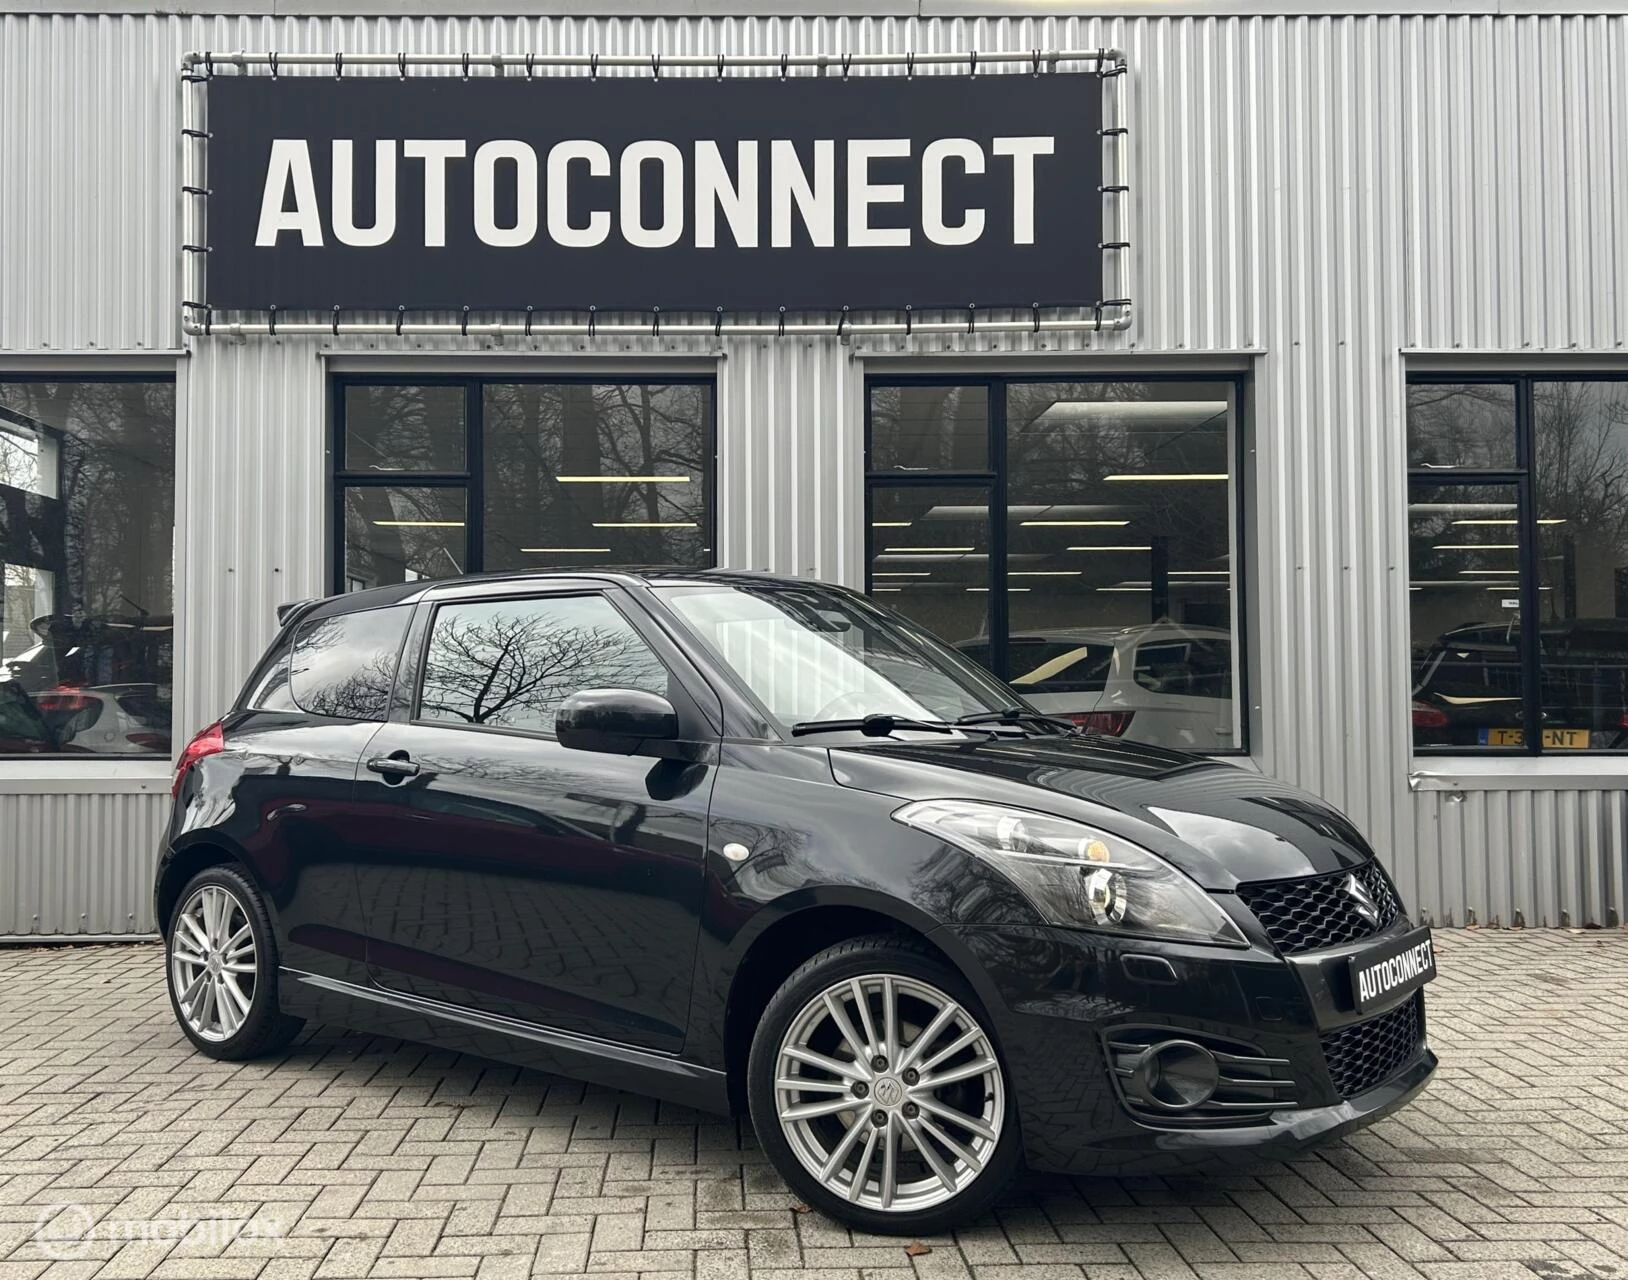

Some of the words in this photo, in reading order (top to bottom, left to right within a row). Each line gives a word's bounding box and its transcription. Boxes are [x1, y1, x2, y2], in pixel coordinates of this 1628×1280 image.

[255, 137, 1054, 247] AUTOCONNECT
[1498, 730, 1577, 746] T-3-NT
[1359, 940, 1432, 1002] AUTOCONNECT
